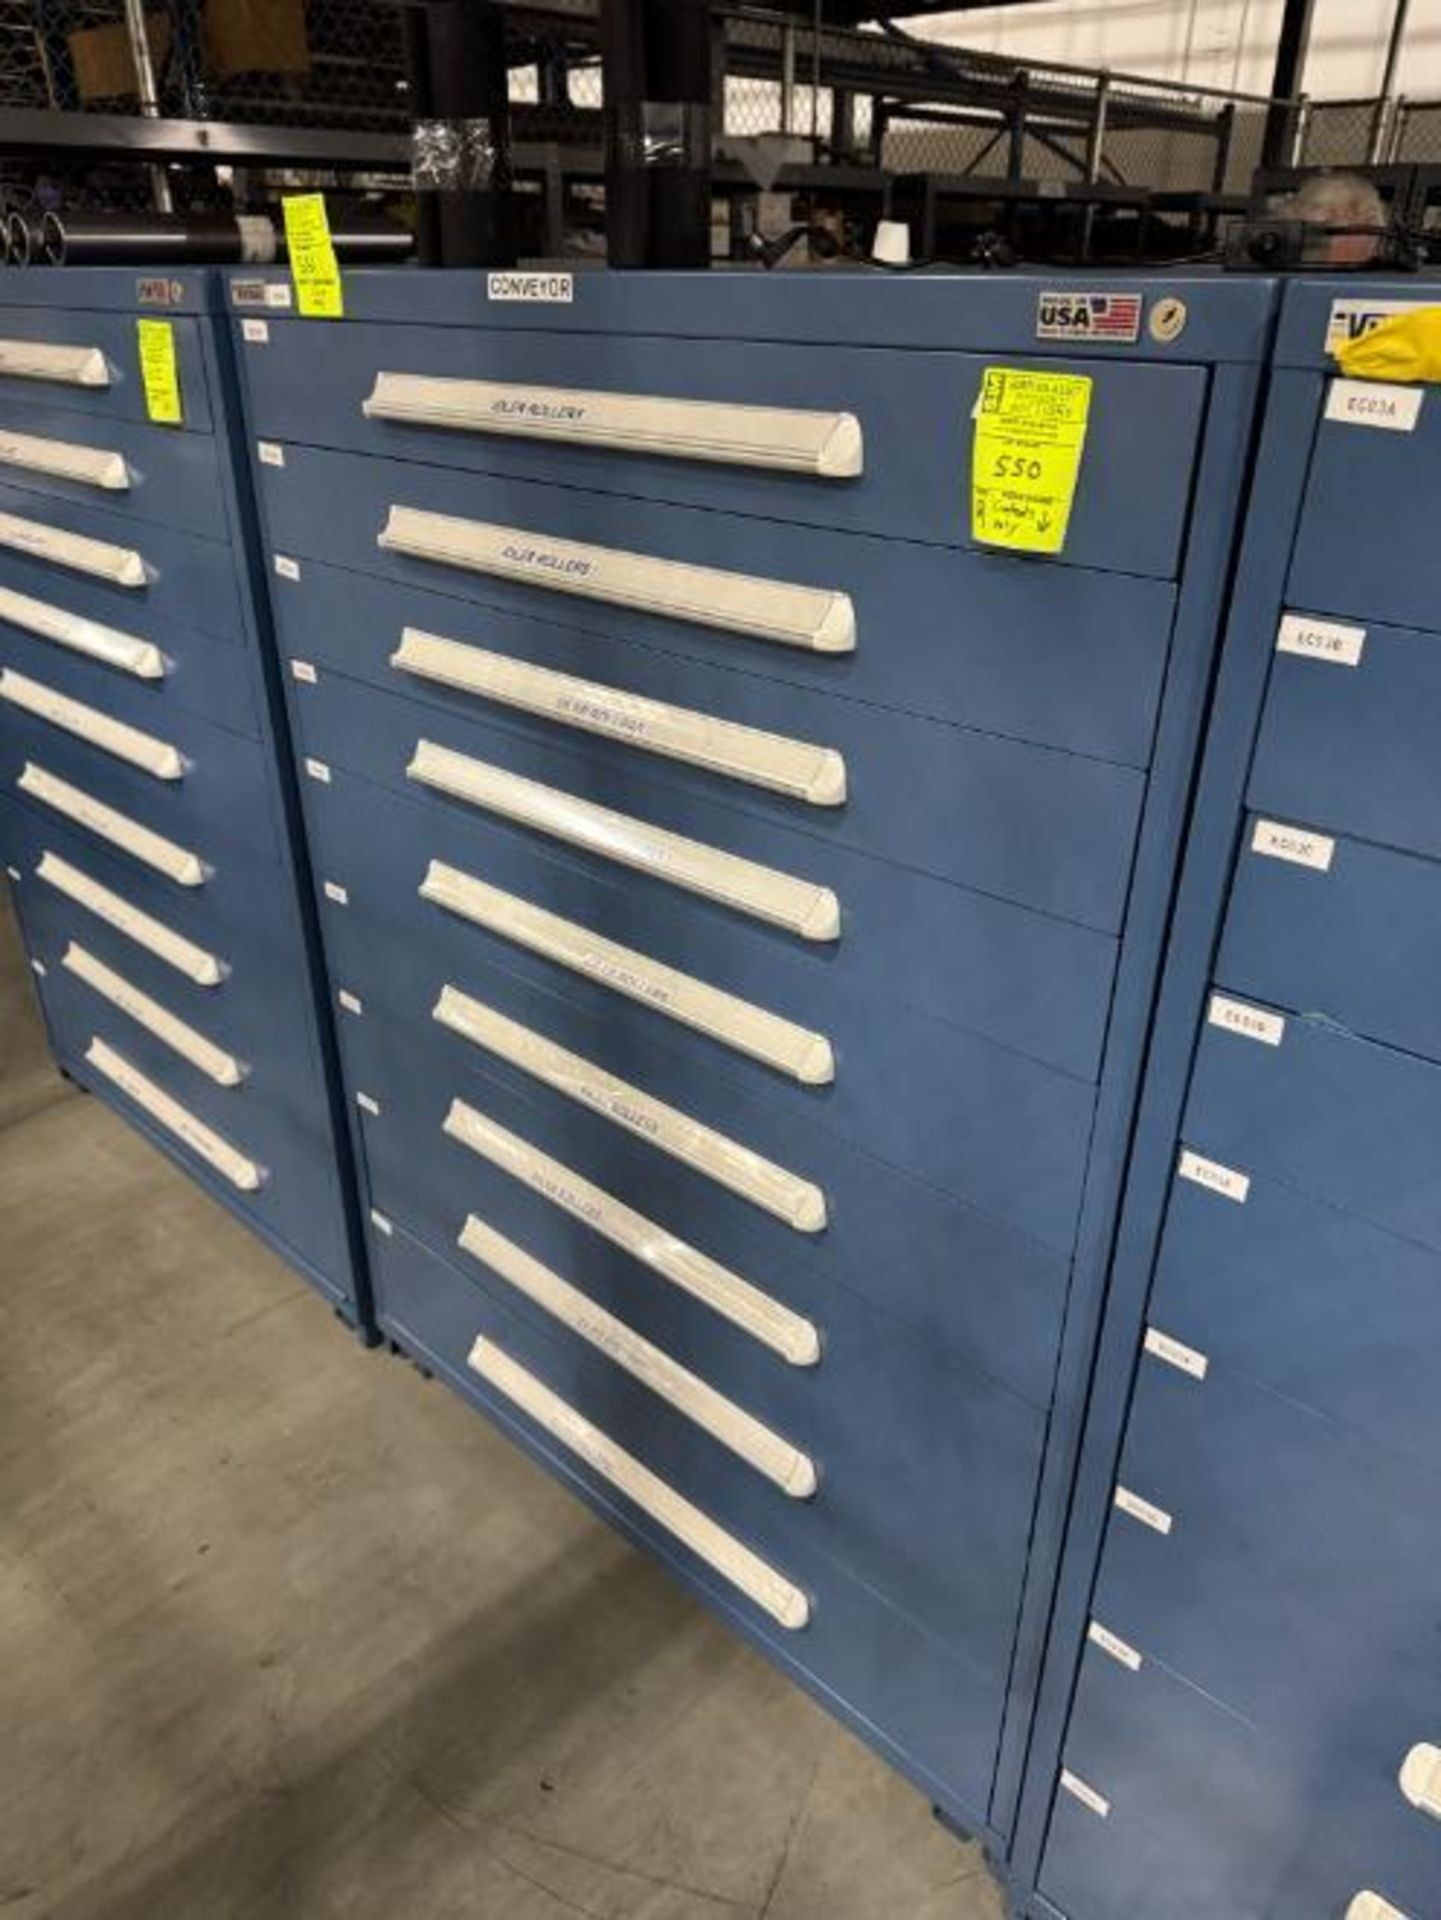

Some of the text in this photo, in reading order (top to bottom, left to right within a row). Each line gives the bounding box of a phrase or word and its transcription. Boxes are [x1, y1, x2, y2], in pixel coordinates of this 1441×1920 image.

[490, 278, 570, 297] CONVEYOR
[1041, 305, 1090, 328] USA
[993, 454, 1041, 479] 550
